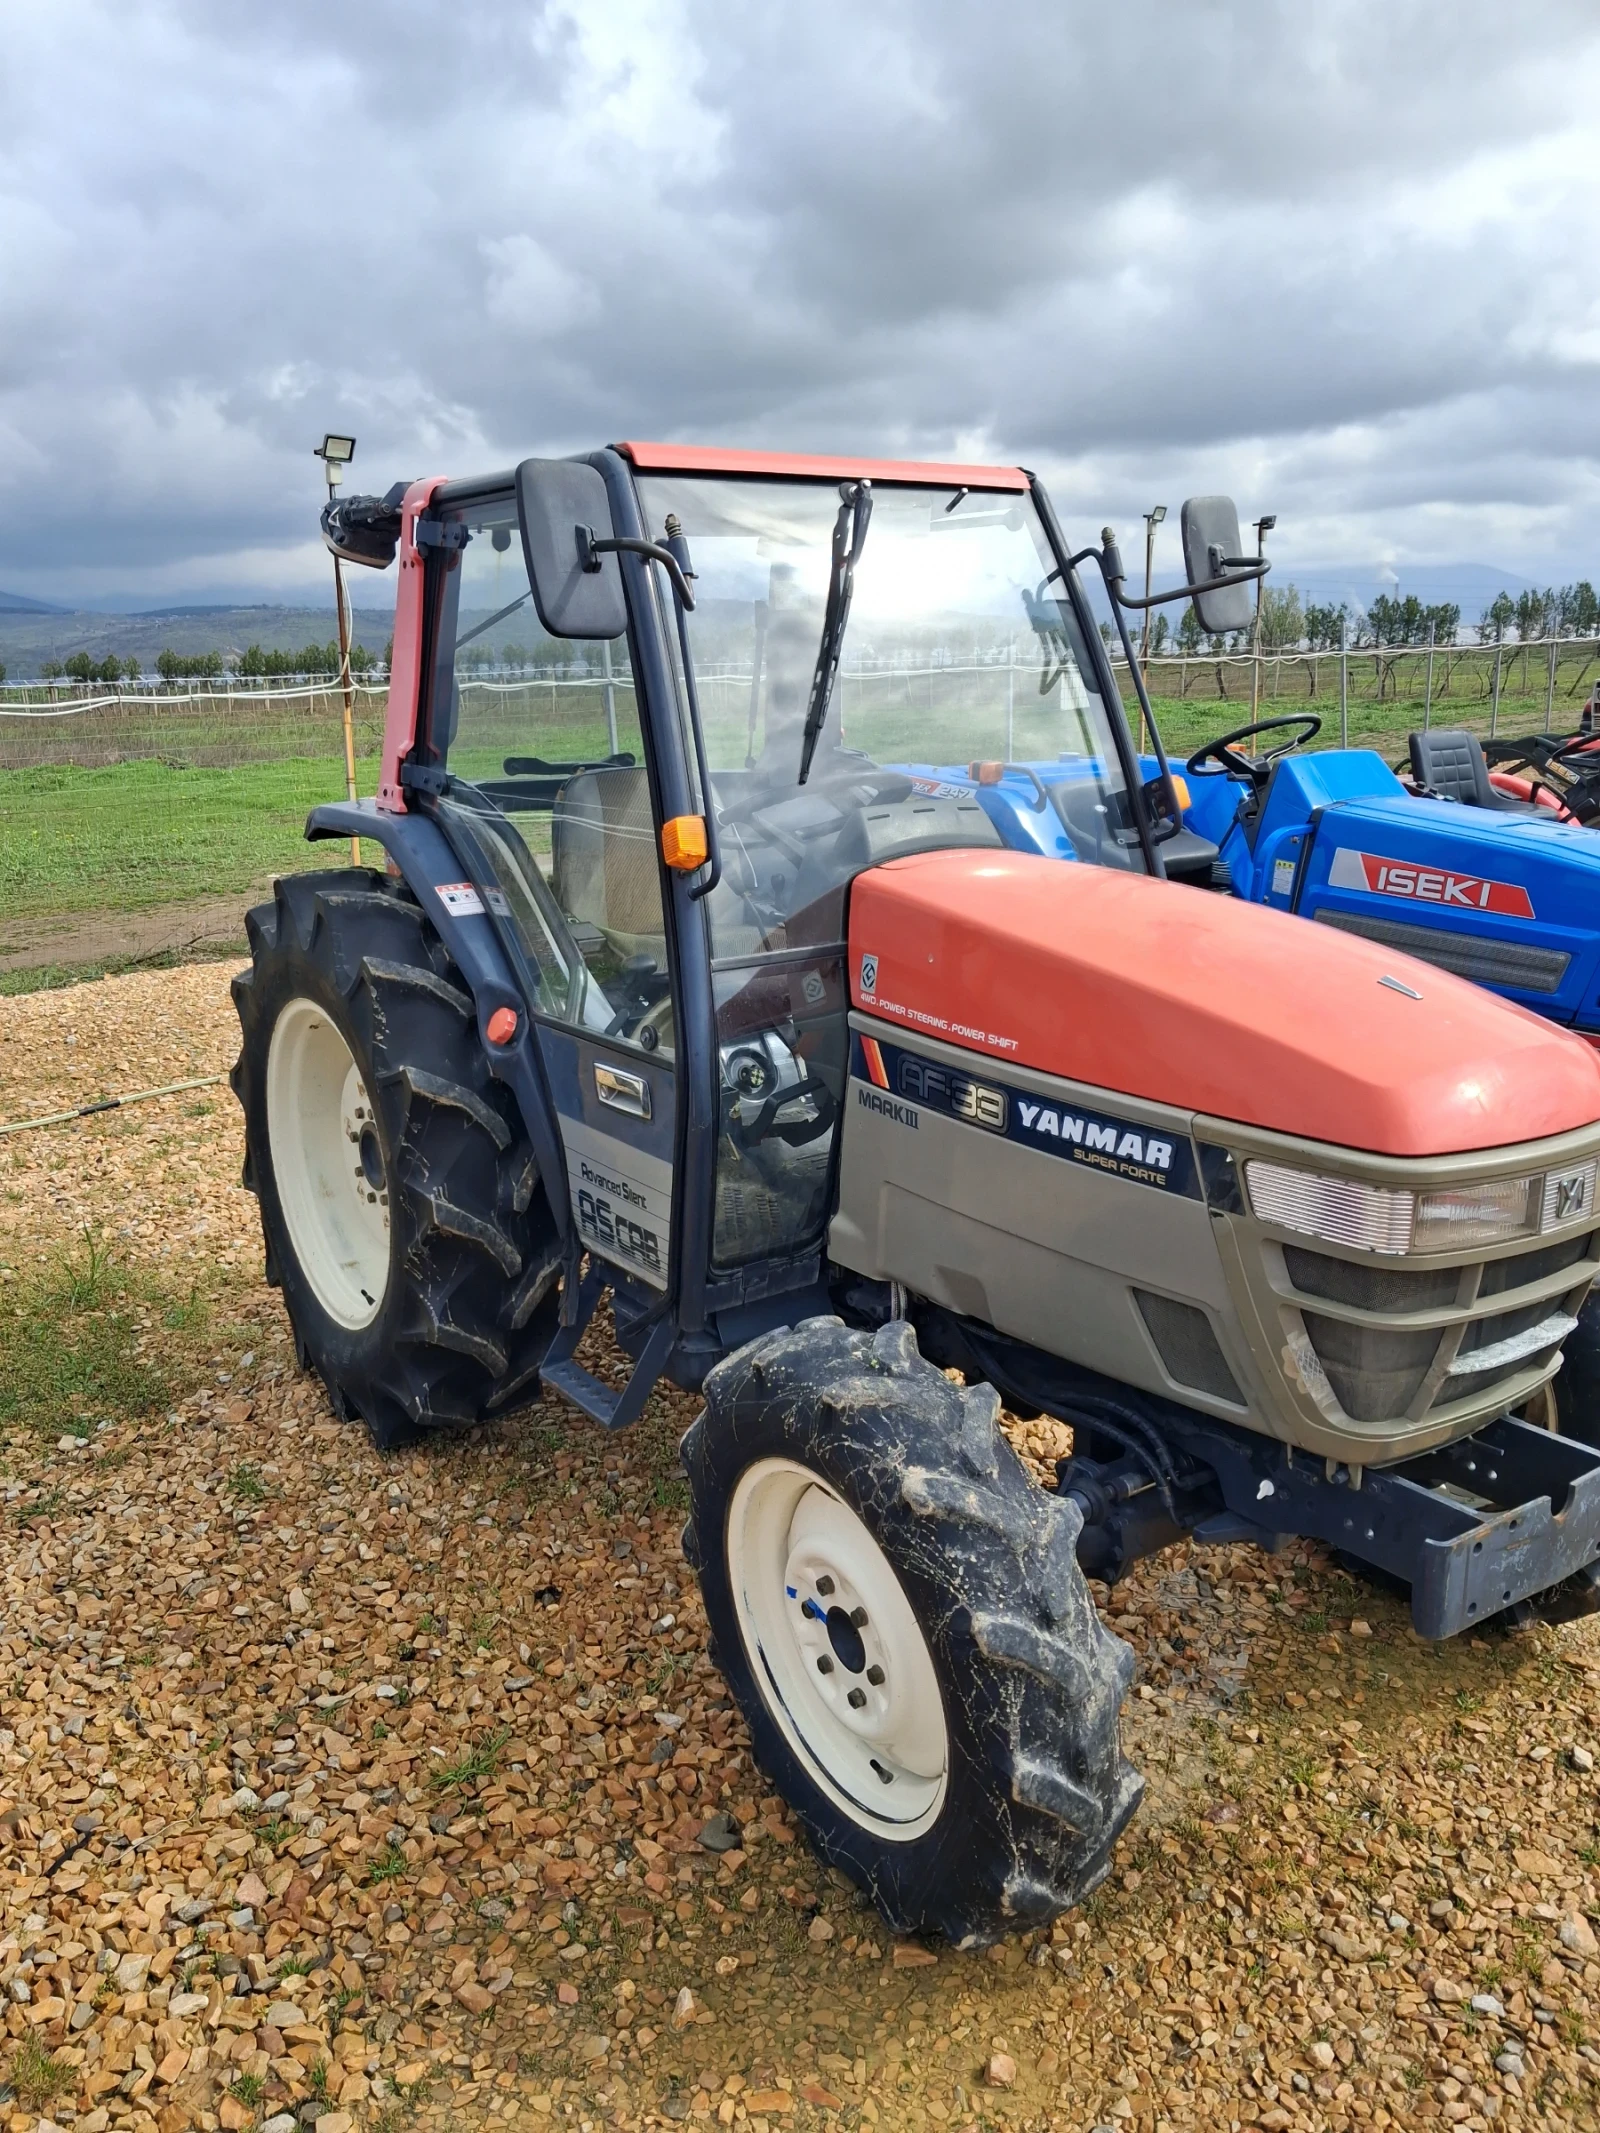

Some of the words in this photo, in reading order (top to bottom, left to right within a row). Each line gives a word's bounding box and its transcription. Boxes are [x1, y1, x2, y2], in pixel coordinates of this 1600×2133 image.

[940, 785, 969, 799] 247
[1377, 866, 1491, 908] ISEKI
[879, 999, 906, 1016] POWER
[951, 1023, 985, 1042] POWER
[987, 1034, 1019, 1051] SHIFT
[1018, 1100, 1172, 1169] YANMAR
[581, 1162, 622, 1196] Advanced
[621, 1182, 647, 1209] Silent
[1073, 1148, 1118, 1173] SUPER
[1120, 1163, 1167, 1186] FORTE
[615, 1213, 661, 1273] CAB
